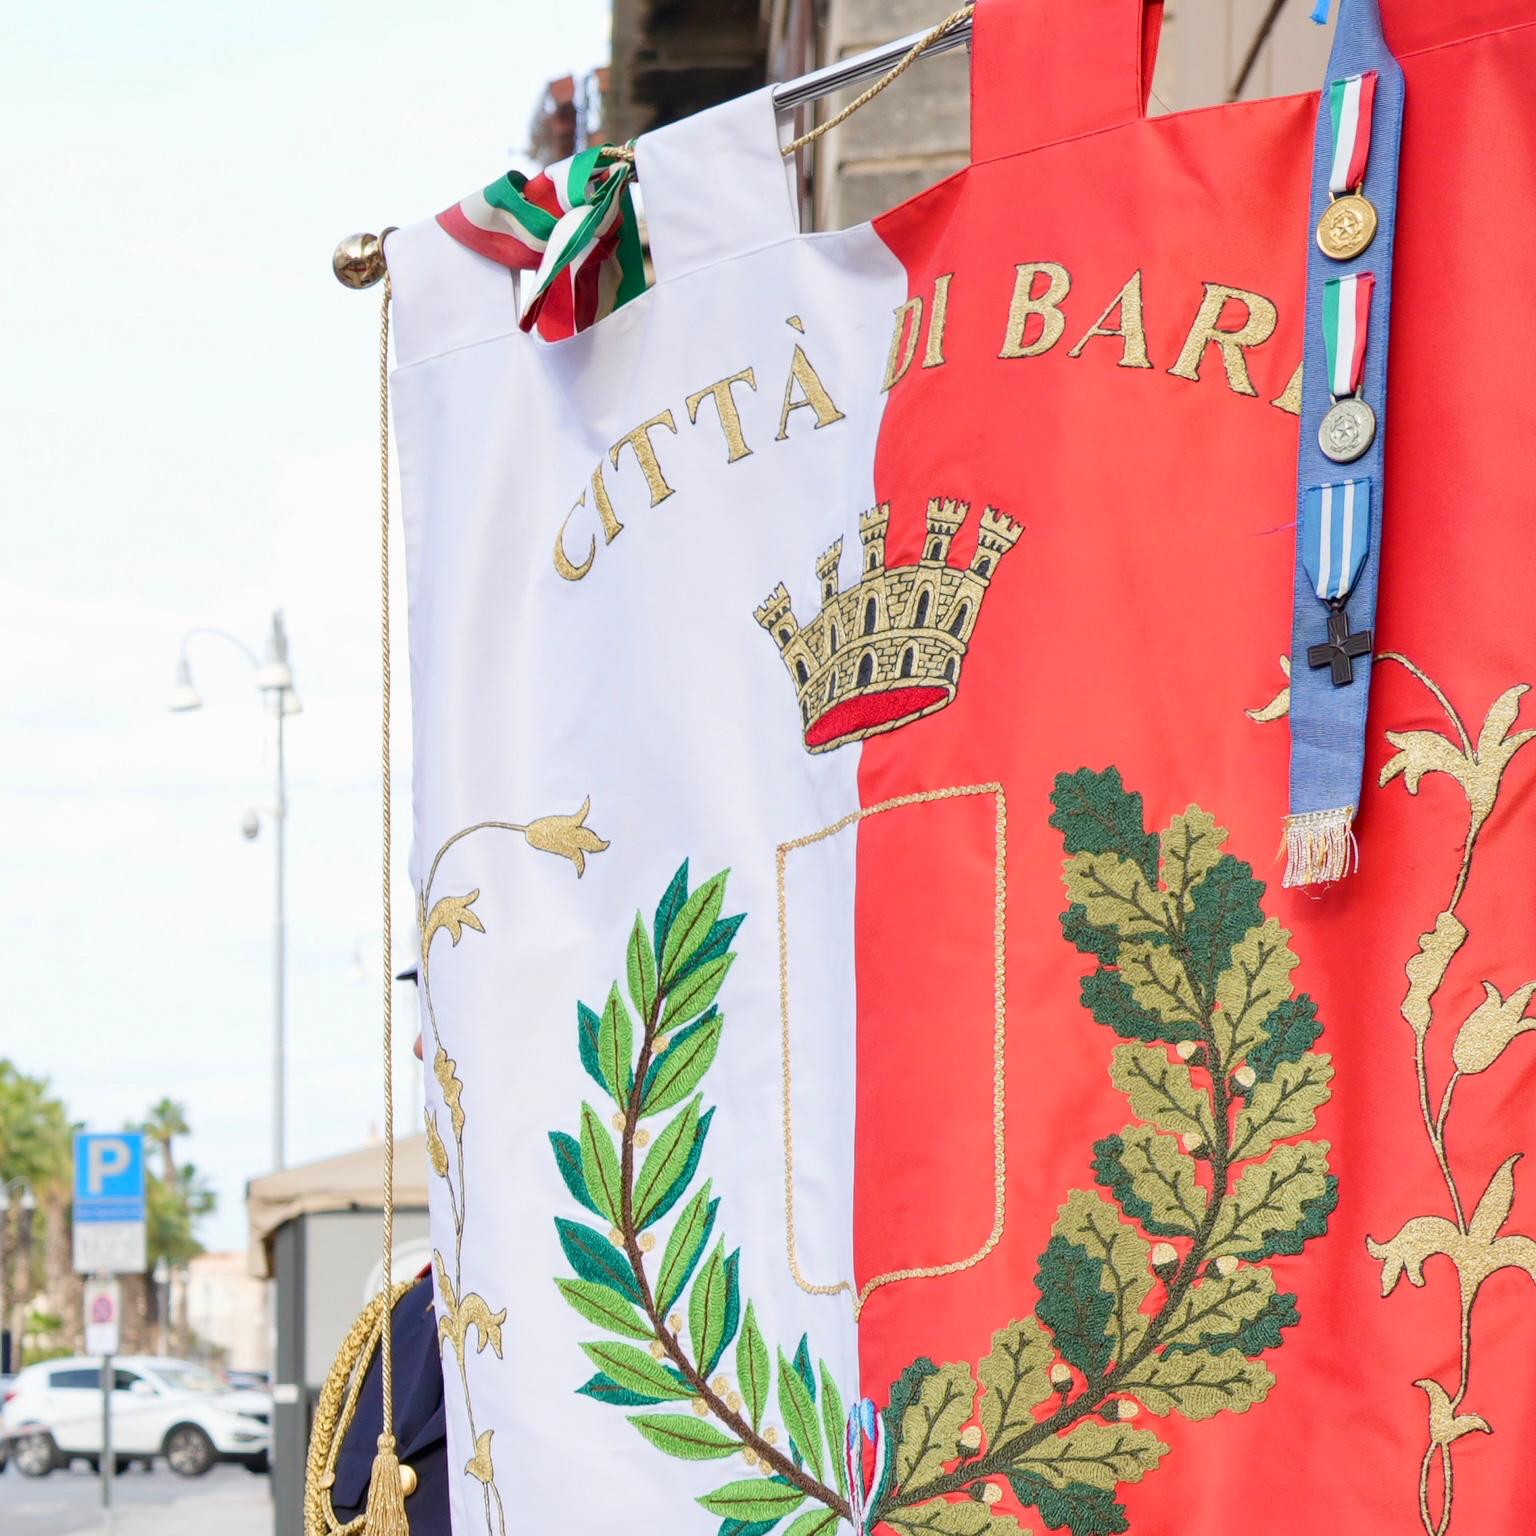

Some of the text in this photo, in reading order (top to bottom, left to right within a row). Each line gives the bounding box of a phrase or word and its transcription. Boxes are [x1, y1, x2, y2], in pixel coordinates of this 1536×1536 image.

[553, 260, 1304, 581] CITTÀ DI BAR
[88, 1138, 132, 1195] P
